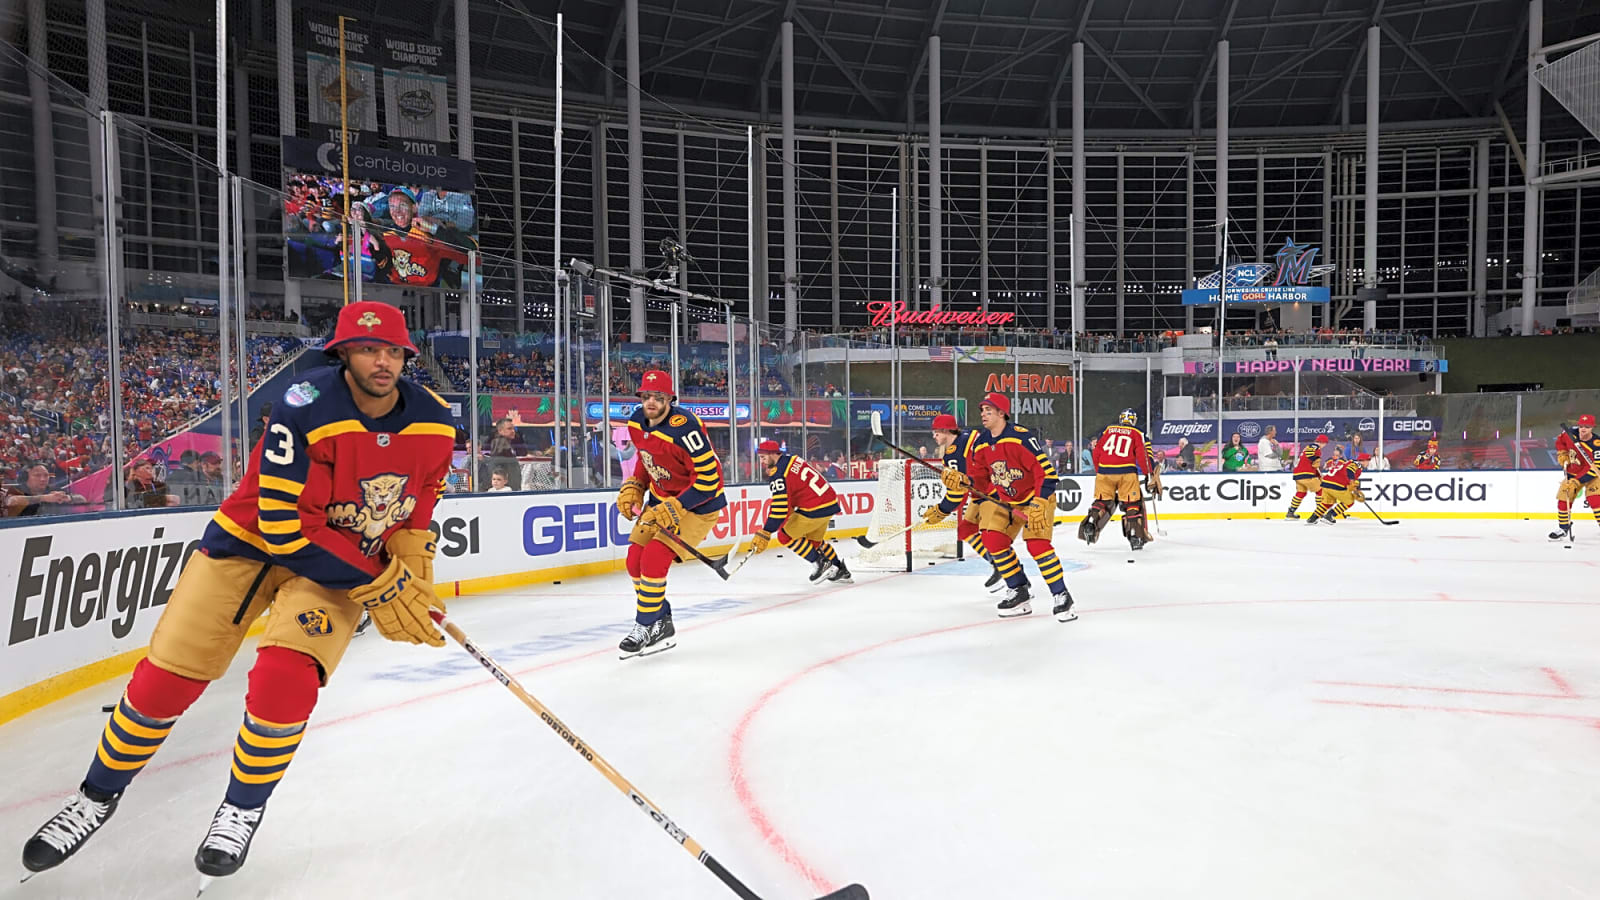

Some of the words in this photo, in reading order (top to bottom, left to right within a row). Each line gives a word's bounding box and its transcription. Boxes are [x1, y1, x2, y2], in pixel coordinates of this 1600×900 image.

[316, 34, 364, 53] CHAMIONS
[344, 29, 369, 44] SERIES
[385, 39, 415, 52] WORLD
[417, 44, 442, 56] SERIES
[392, 51, 437, 66] CHAMPIONS
[403, 141, 437, 156] 2003
[354, 155, 447, 178] cantaloupe
[1238, 269, 1256, 277] NCL
[867, 300, 1015, 327] Budweiser
[1236, 361, 1304, 373] HAPPY
[1312, 360, 1354, 372] NEW
[1360, 359, 1410, 372] YEAR!
[1011, 398, 1054, 415] BANK
[1161, 423, 1212, 435] Energizer
[1393, 420, 1432, 431] GEICO
[681, 431, 705, 453] 10
[1103, 434, 1132, 458] 40
[770, 478, 785, 493] 26
[1217, 479, 1281, 506] Clips
[1358, 478, 1486, 506] Expedia
[1056, 489, 1082, 503] TNT
[523, 502, 632, 556] GEIC
[8, 527, 202, 646] Energiz
[363, 569, 412, 610] CCM
[465, 643, 510, 686] CCM
[540, 711, 576, 746] CUSTOM
[575, 744, 593, 762] PRO
[632, 794, 686, 845] CCM
